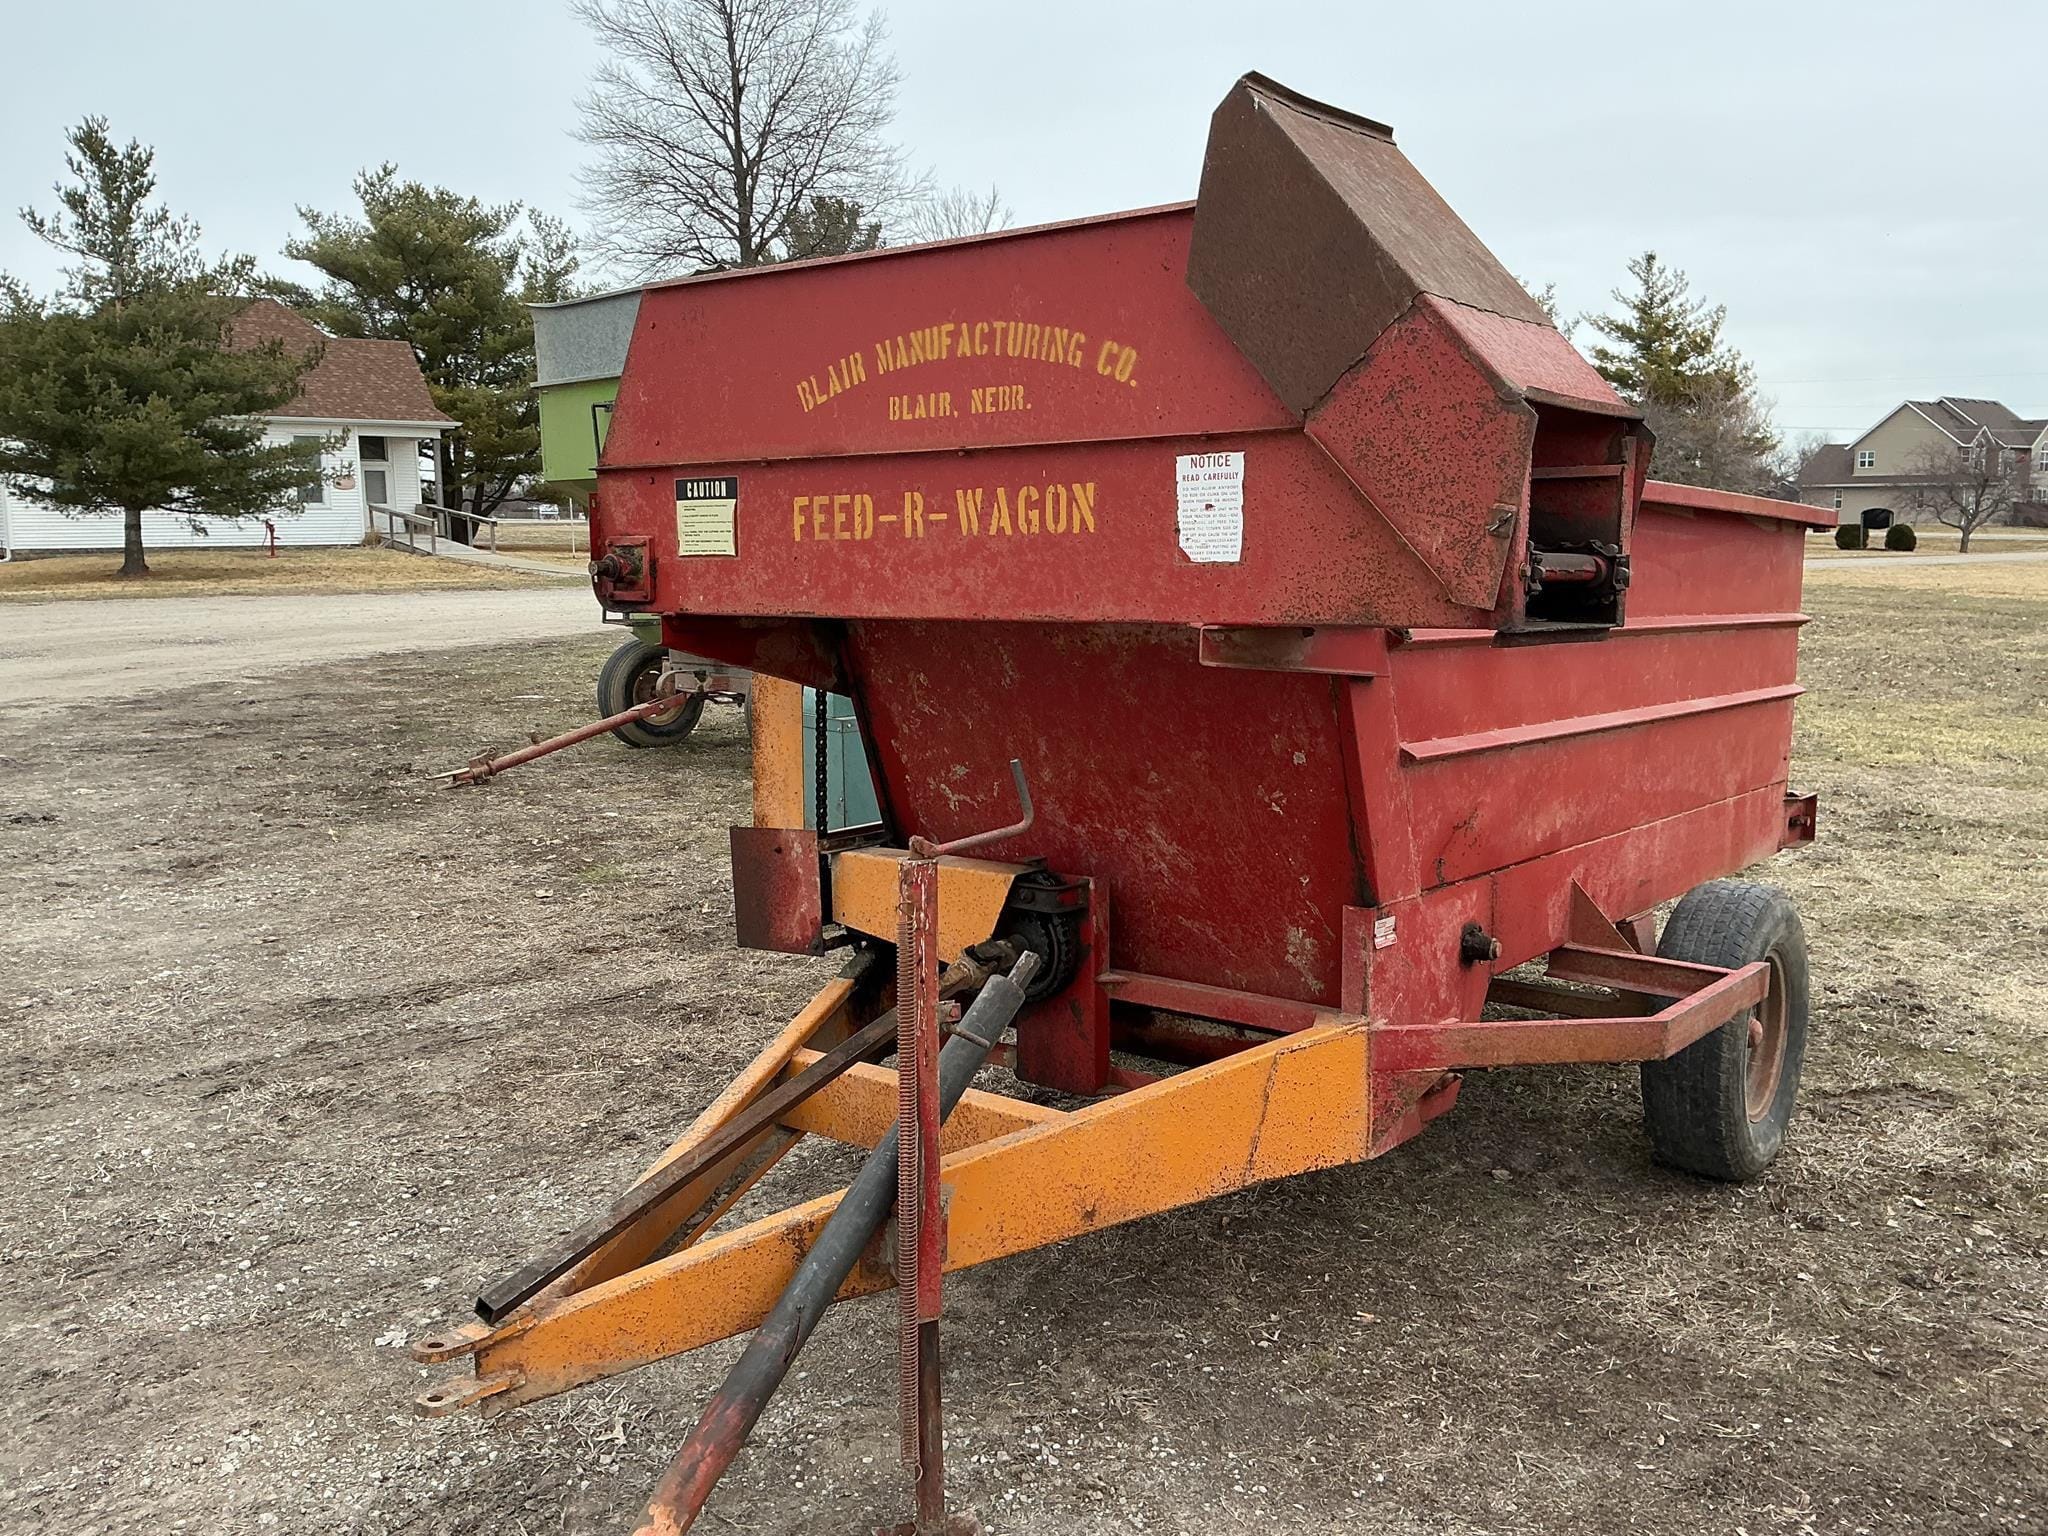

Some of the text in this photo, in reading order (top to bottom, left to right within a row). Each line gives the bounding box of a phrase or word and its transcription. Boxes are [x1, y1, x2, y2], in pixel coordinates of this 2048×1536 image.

[796, 321, 1138, 412] BLAIR MANUFACTURING CO.
[889, 385, 1032, 421] BLAIR, NEBR.
[1190, 455, 1231, 469] NOTICE
[1182, 471, 1239, 482] READ CAREFULLY
[687, 481, 726, 497] CAUTION
